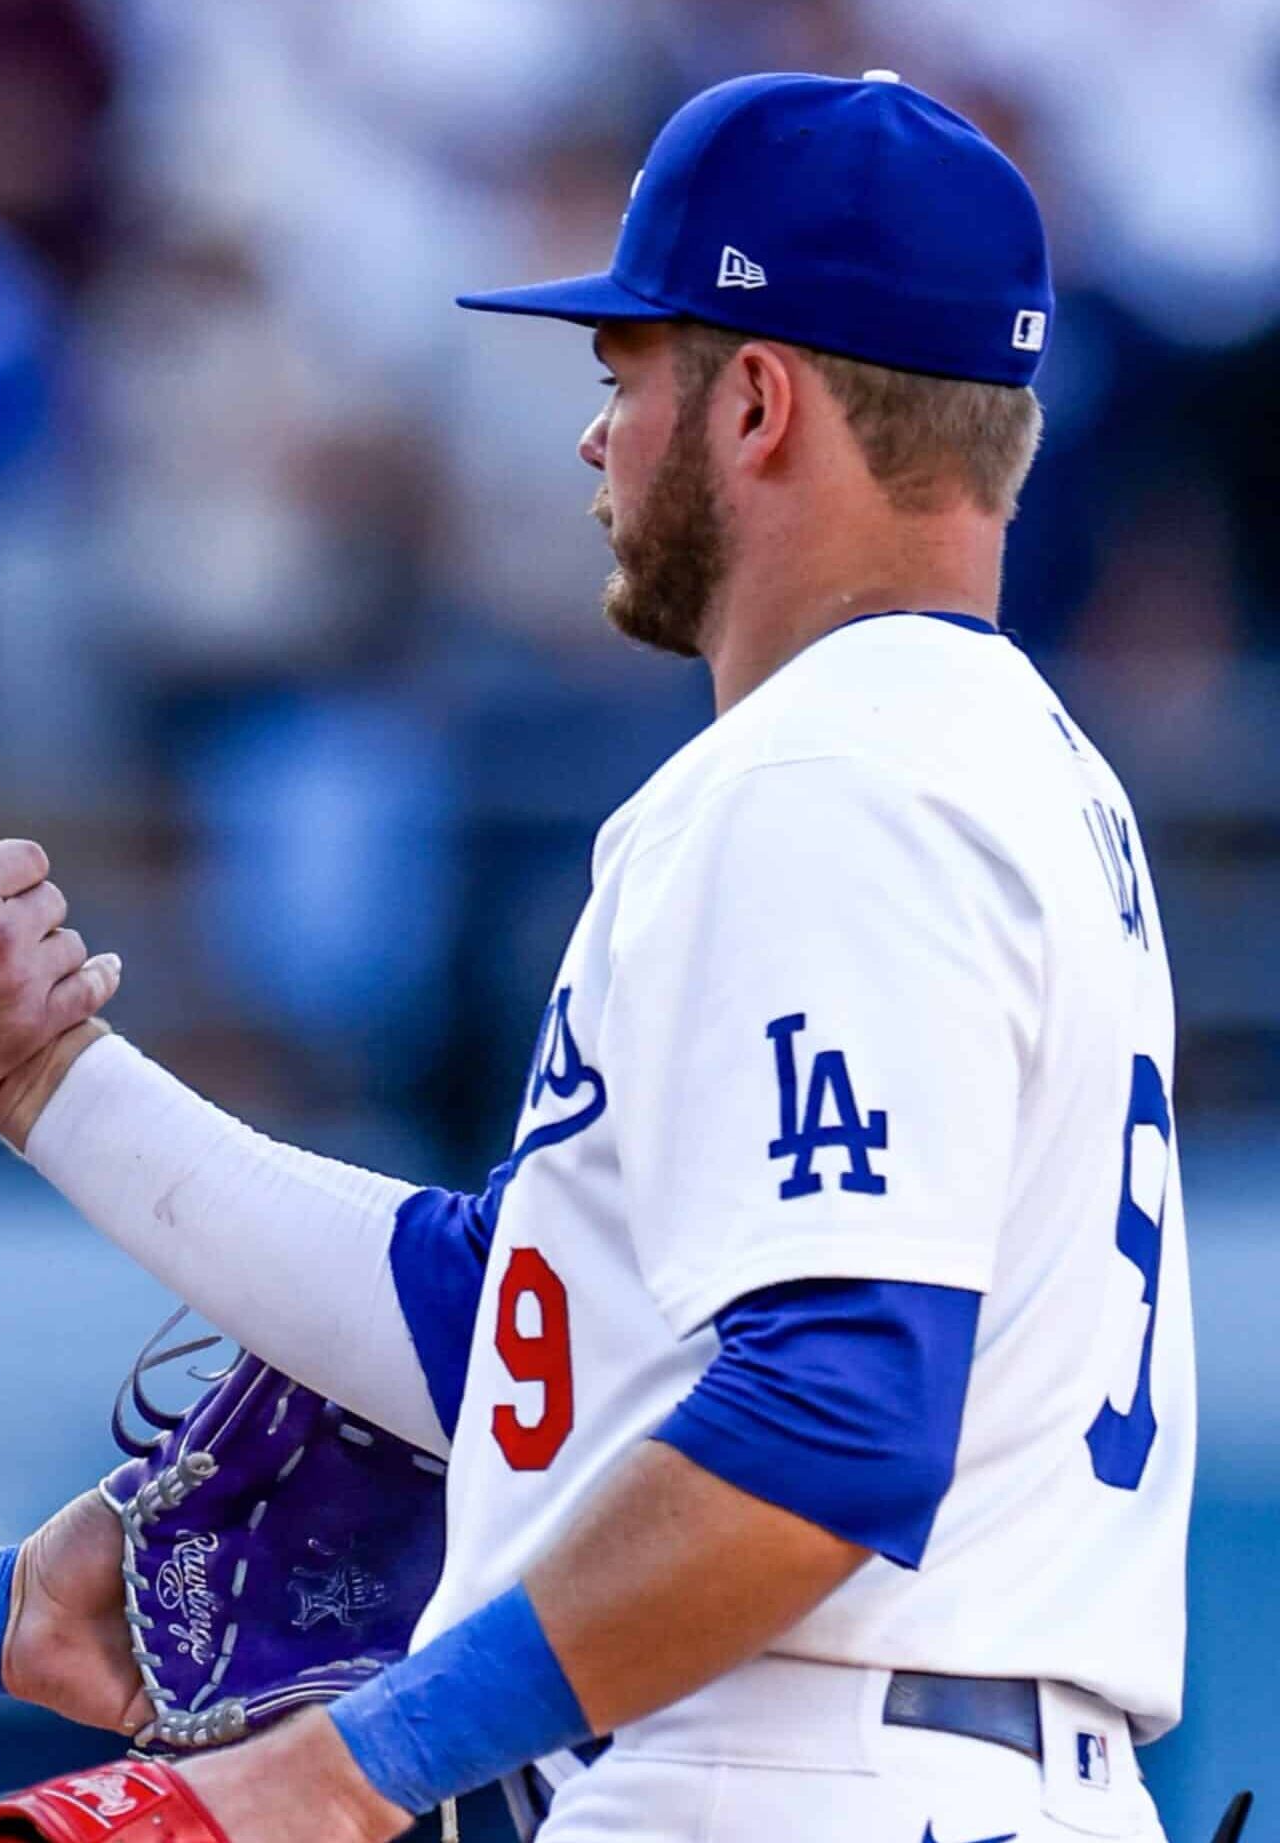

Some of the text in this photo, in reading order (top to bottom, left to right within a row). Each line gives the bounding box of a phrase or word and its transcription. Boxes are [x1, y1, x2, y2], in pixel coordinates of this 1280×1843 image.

[766, 1012, 888, 1201] LA
[491, 1247, 575, 1471] 9
[1084, 1053, 1170, 1491] 9
[168, 1529, 219, 1665] Rawlings
